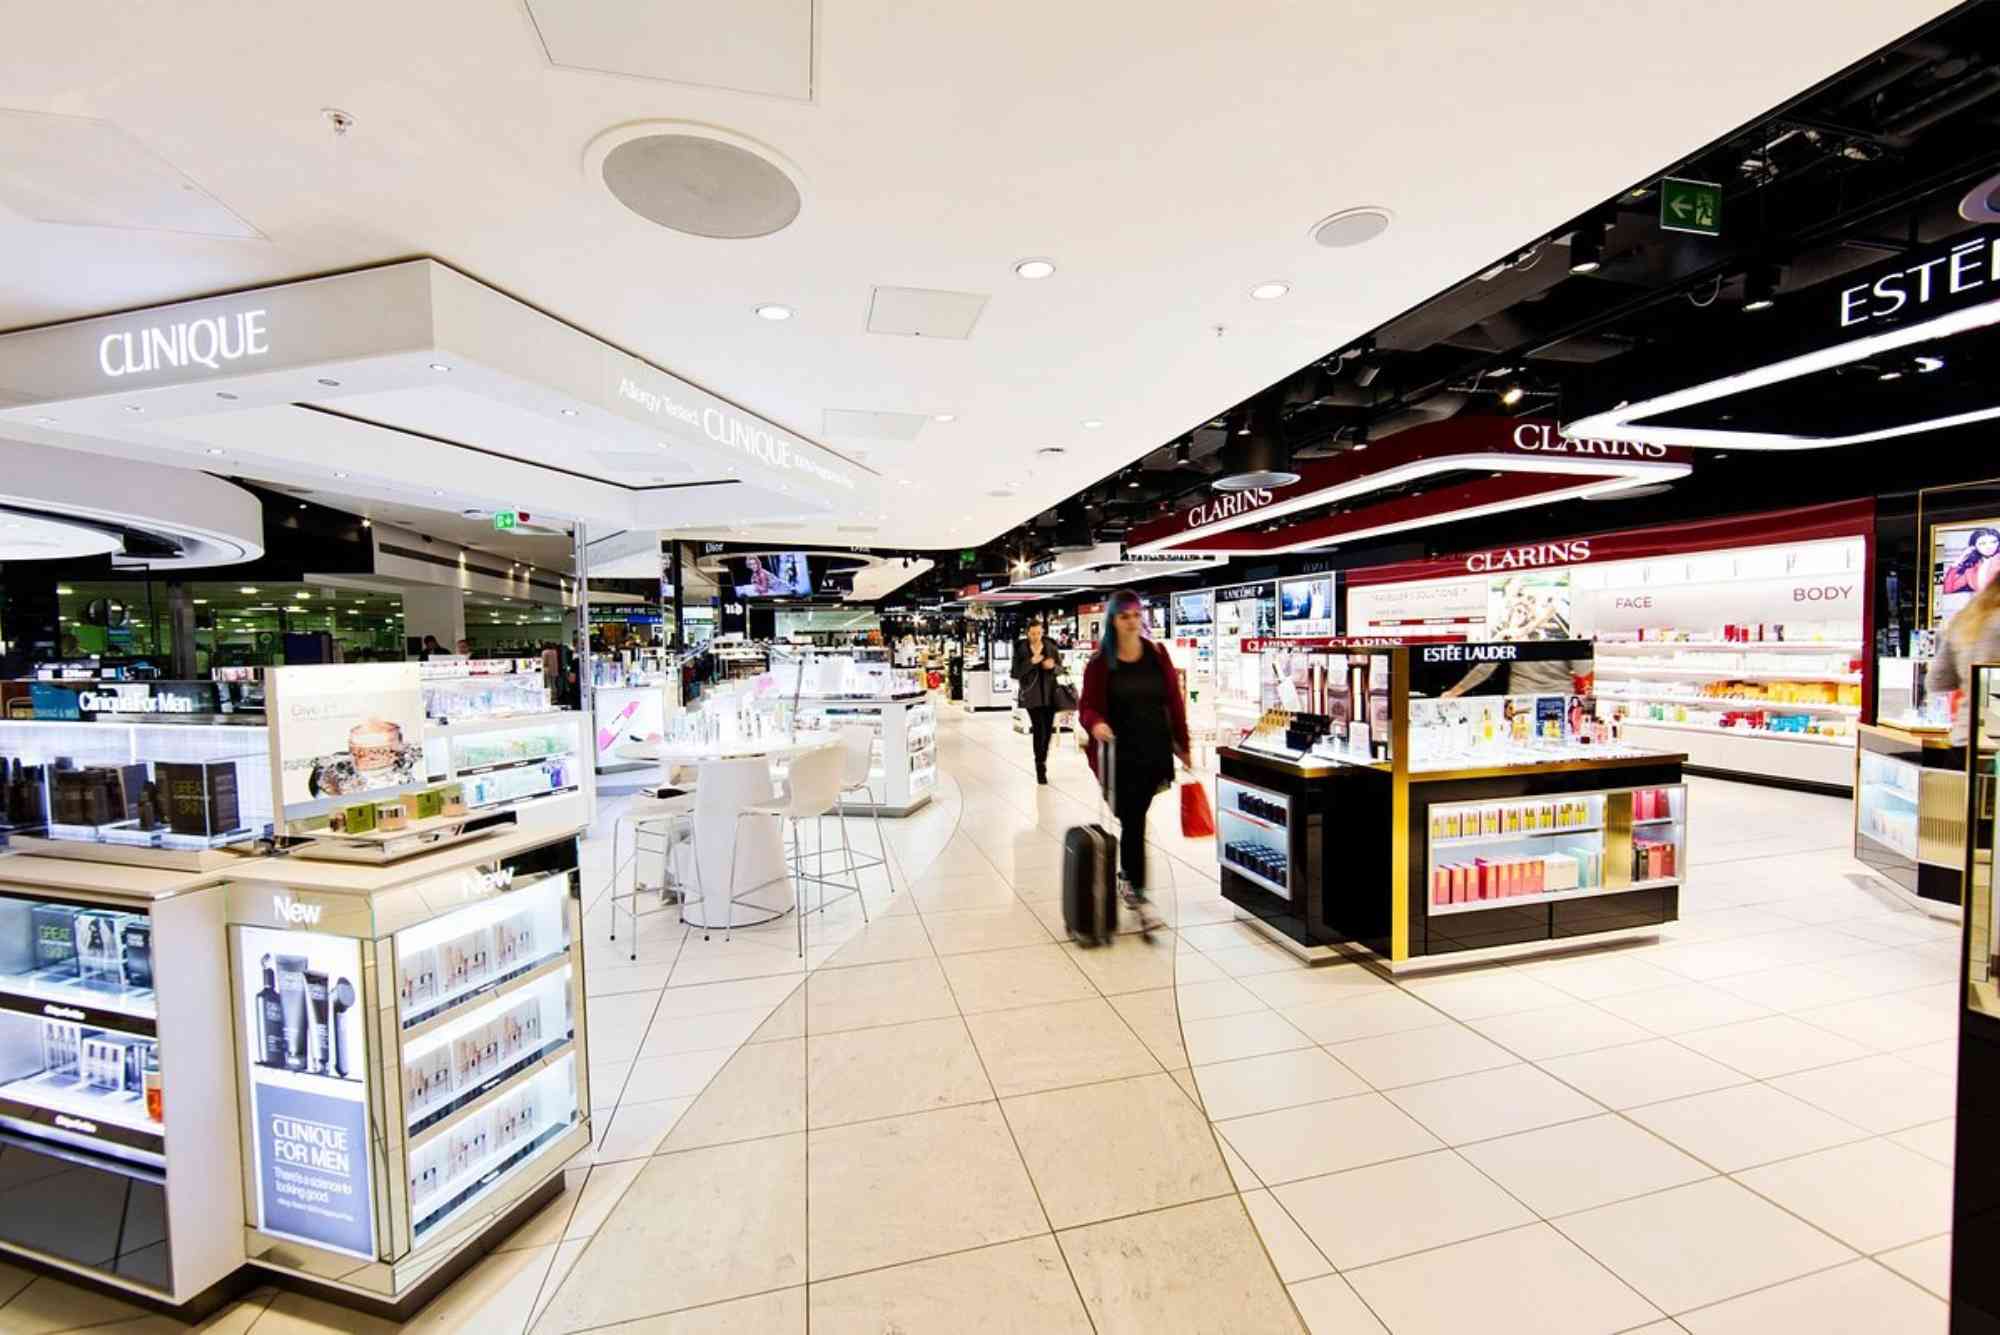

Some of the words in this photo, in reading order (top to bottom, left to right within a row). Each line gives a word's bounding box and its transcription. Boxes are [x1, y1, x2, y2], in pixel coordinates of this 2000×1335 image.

[100, 309, 269, 376] CLINIQUE
[619, 378, 661, 414] Allergy
[703, 408, 793, 468] CLINIQUE
[1188, 487, 1274, 527] CLARINS
[1466, 540, 1591, 573] CLARINS
[1616, 596, 1653, 609] FACE
[1793, 586, 1853, 602] BODY
[1465, 645, 1517, 661] LAUDER
[79, 691, 136, 714] Clinique
[136, 692, 157, 712] For
[158, 692, 193, 713] Men
[464, 866, 516, 898] New
[273, 896, 321, 923] New
[272, 1119, 349, 1151] CLINIQUE
[274, 1139, 308, 1163] FOR
[311, 1147, 350, 1173] MEN
